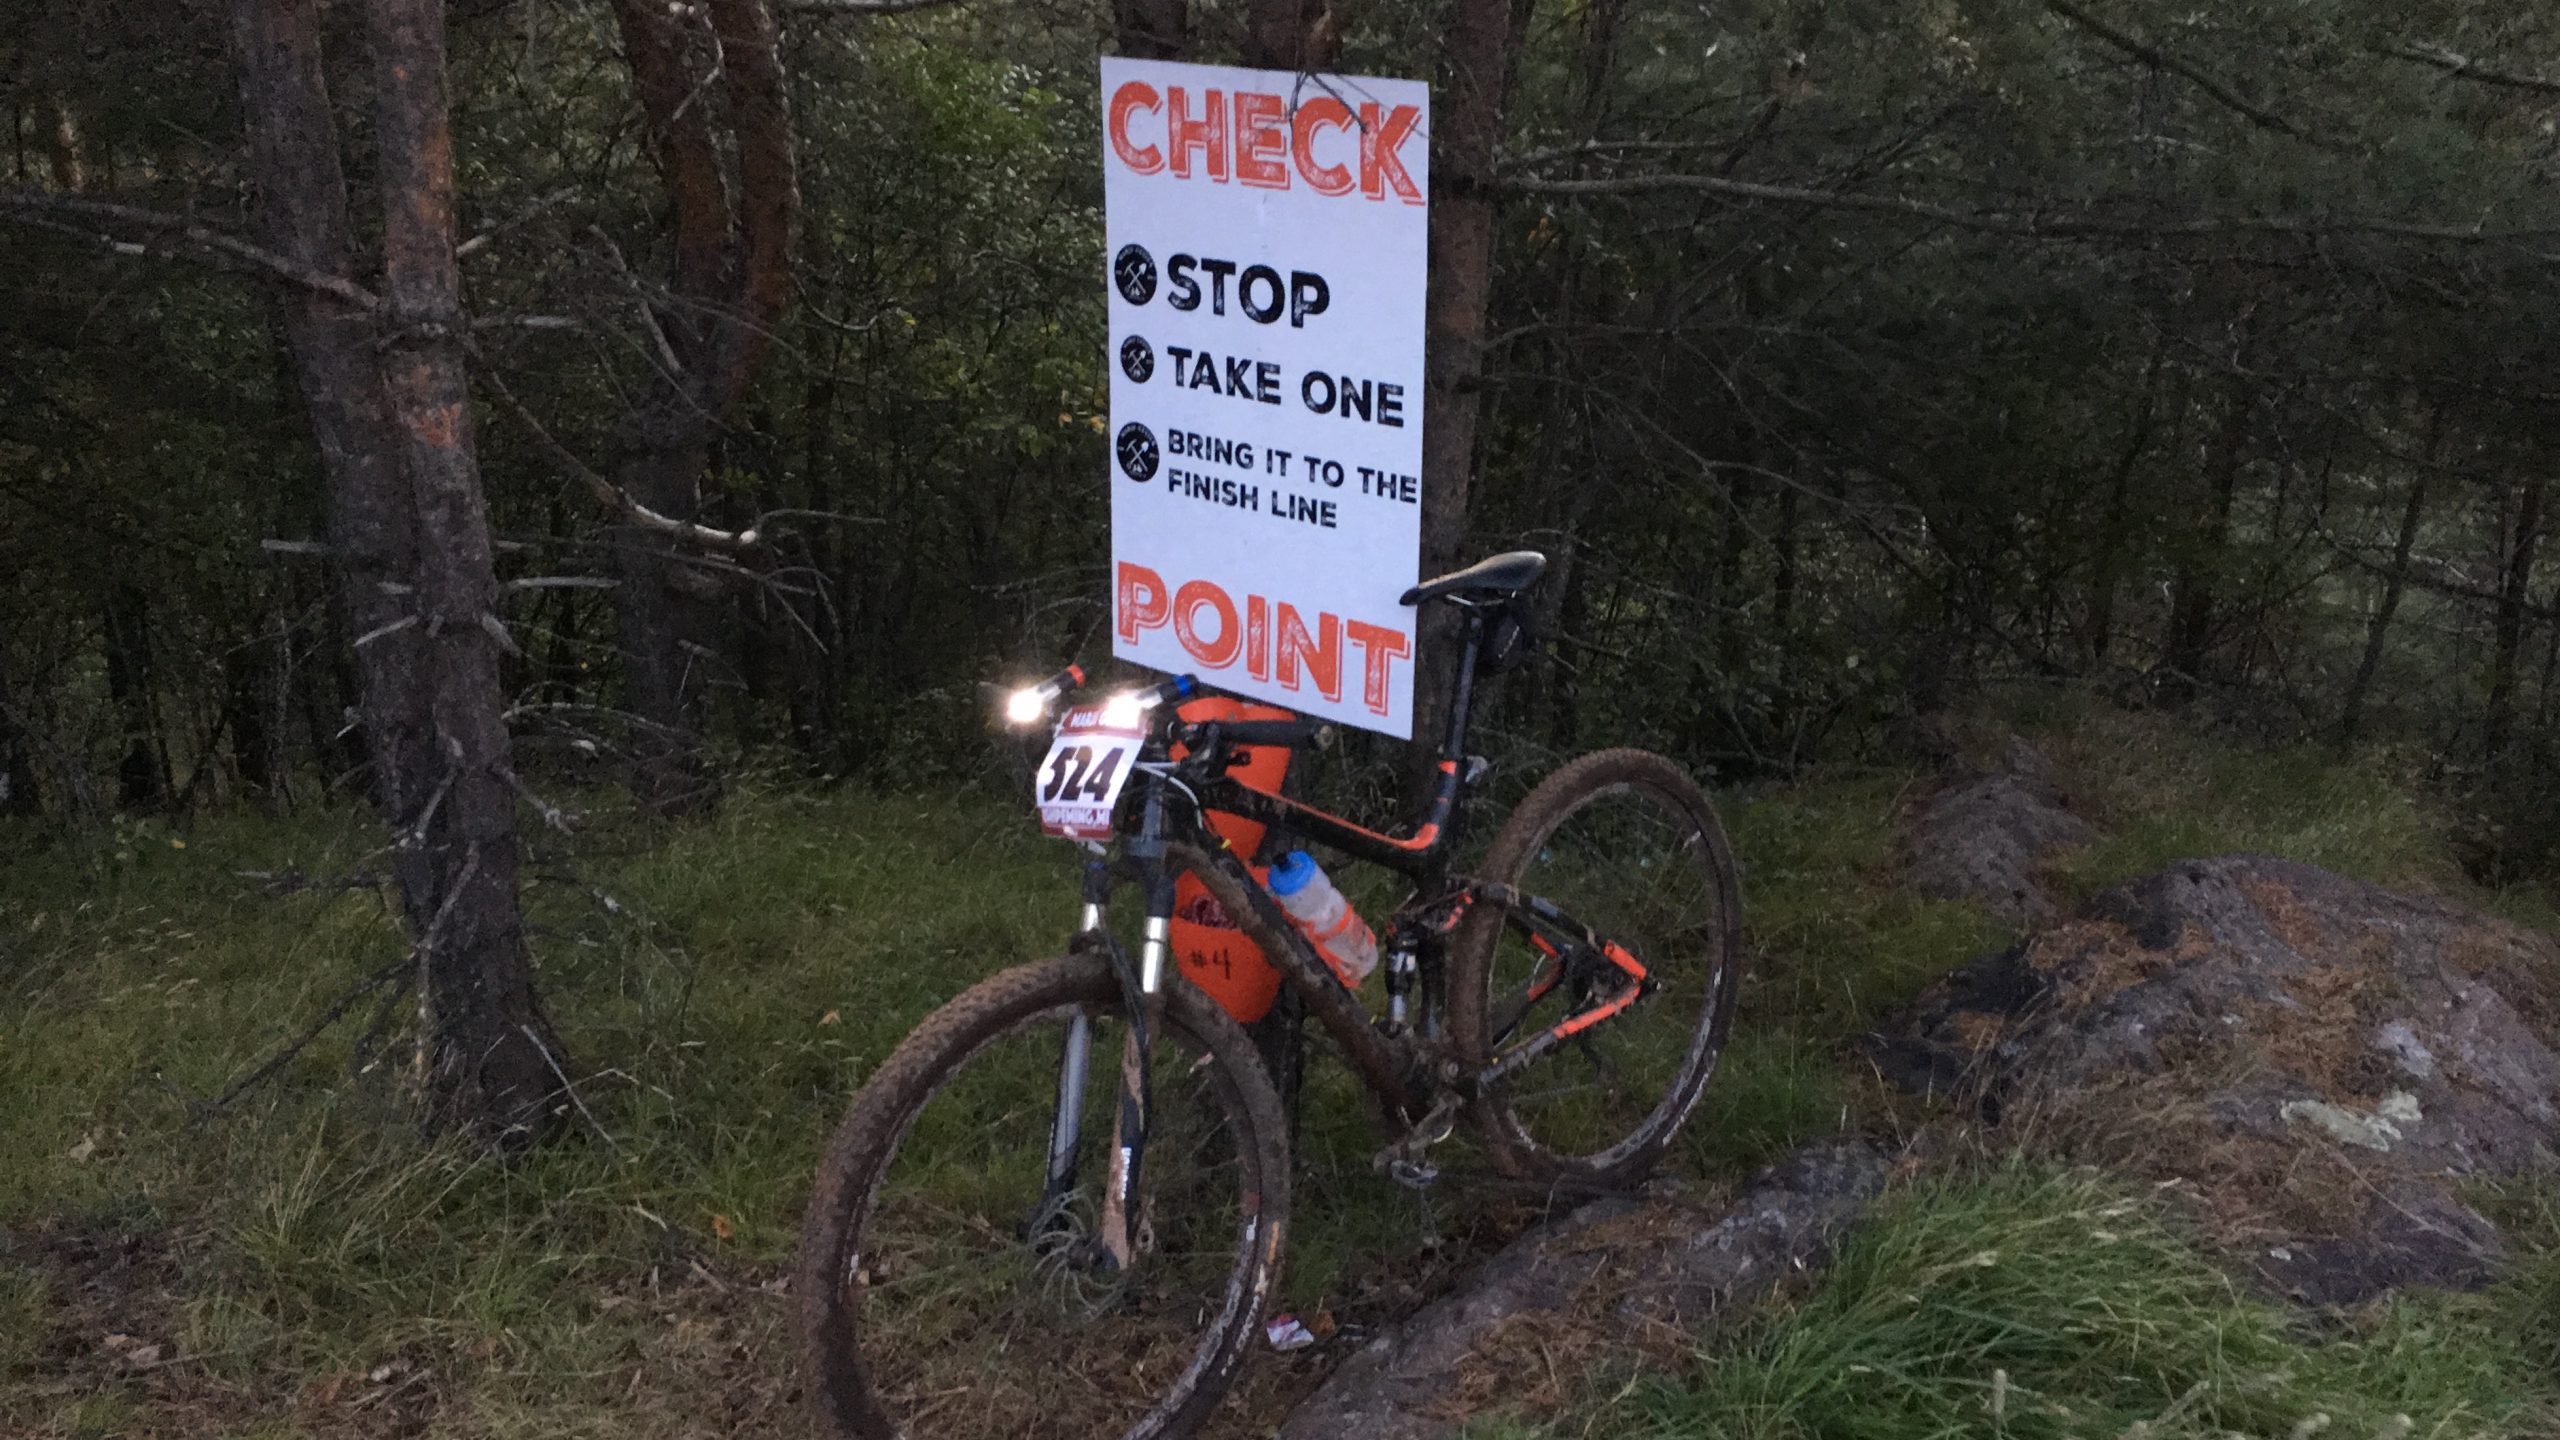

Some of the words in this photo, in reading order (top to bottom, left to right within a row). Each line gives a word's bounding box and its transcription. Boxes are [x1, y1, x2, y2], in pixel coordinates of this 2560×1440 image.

[1109, 81, 1426, 206] CHECK
[1167, 254, 1331, 329] STOP
[1167, 346, 1282, 406] TAKE
[1302, 371, 1405, 429] ONE
[1168, 428, 1254, 470] BRING
[1266, 448, 1292, 477] IT
[1304, 456, 1344, 488] TO
[1357, 466, 1417, 504] THE
[1168, 468, 1258, 512] FINISH
[1271, 490, 1337, 529] LINE
[1118, 561, 1410, 716] POINT
[1044, 745, 1125, 802] 524
[1189, 946, 1232, 981] #4
